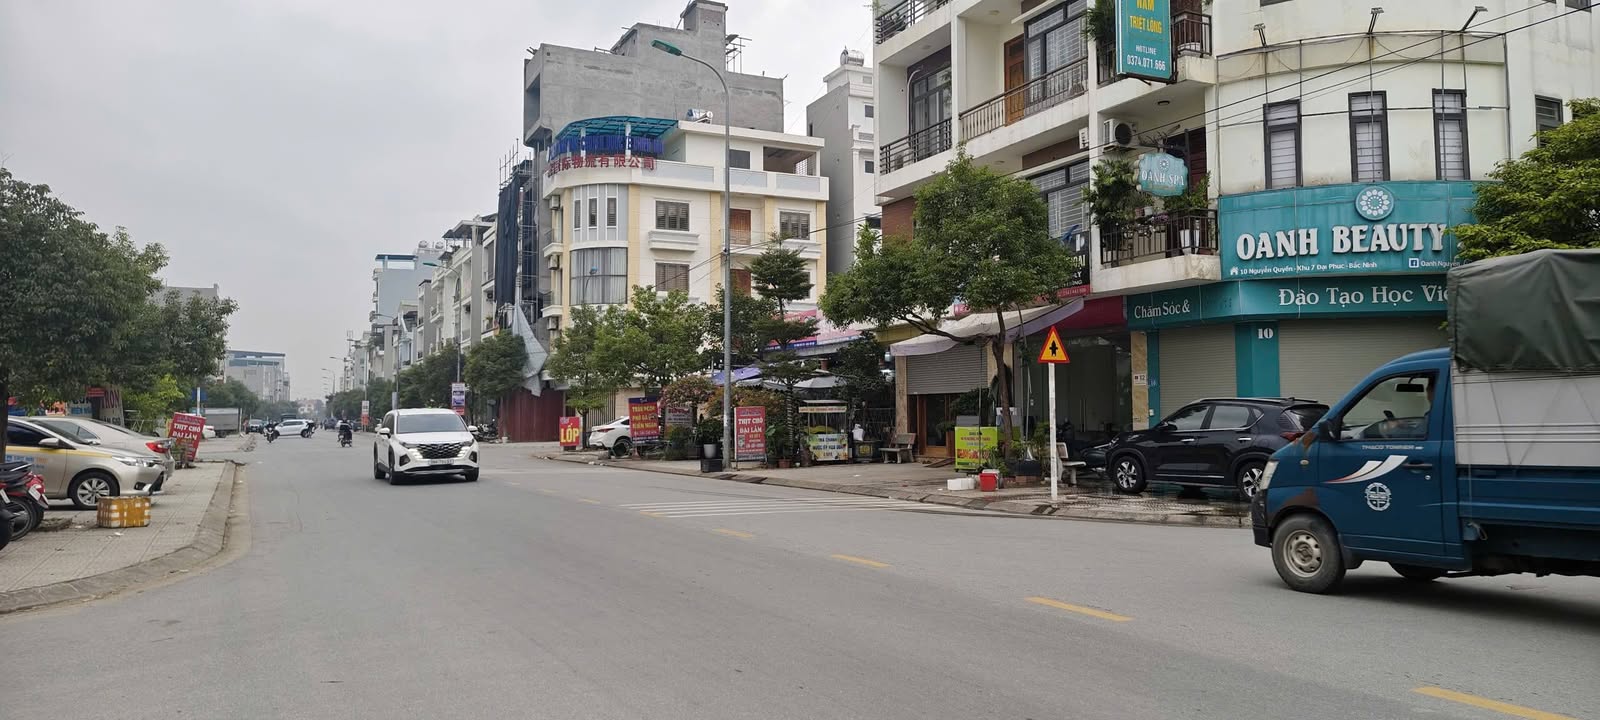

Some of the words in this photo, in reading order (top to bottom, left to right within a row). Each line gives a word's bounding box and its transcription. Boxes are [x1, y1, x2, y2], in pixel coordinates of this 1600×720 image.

[1135, 45, 1157, 55] HOTLINE
[1141, 169, 1165, 183] OANH
[1236, 227, 1319, 261] OANH
[1332, 223, 1447, 254] BEAUTY
[1248, 265, 1272, 275] Nguyễn
[1362, 261, 1378, 269] Ninh
[1279, 288, 1319, 306] Đào
[1326, 287, 1364, 308] Tạo
[1372, 286, 1413, 306] Học
[1134, 305, 1161, 319] Chăm
[1162, 301, 1181, 316] Sóc
[1182, 299, 1190, 313] &
[1257, 328, 1274, 339] 10
[561, 422, 580, 443] LỐP
